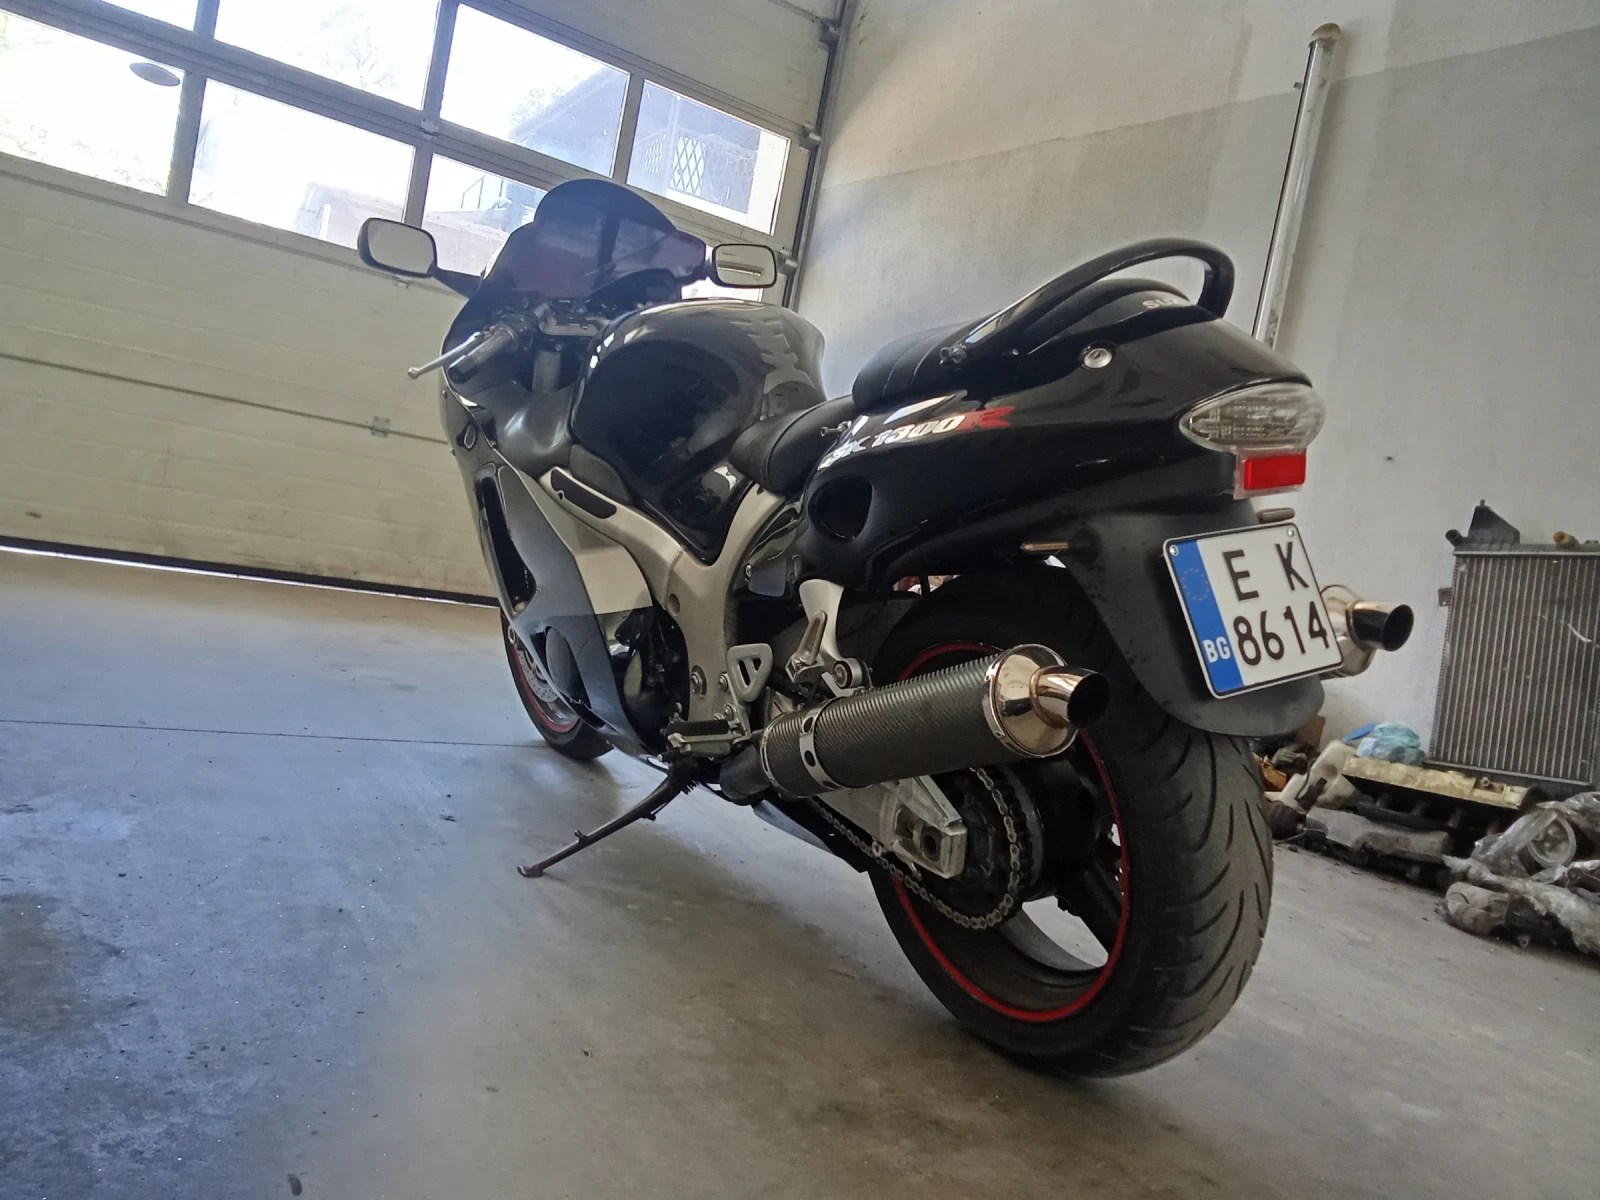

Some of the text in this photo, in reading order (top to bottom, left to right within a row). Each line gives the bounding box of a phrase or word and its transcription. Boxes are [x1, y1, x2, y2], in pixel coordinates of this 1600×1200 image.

[872, 406, 1016, 448] 1300R
[1222, 541, 1310, 601] E K
[1203, 636, 1232, 663] BG
[1233, 601, 1330, 666] 8614
